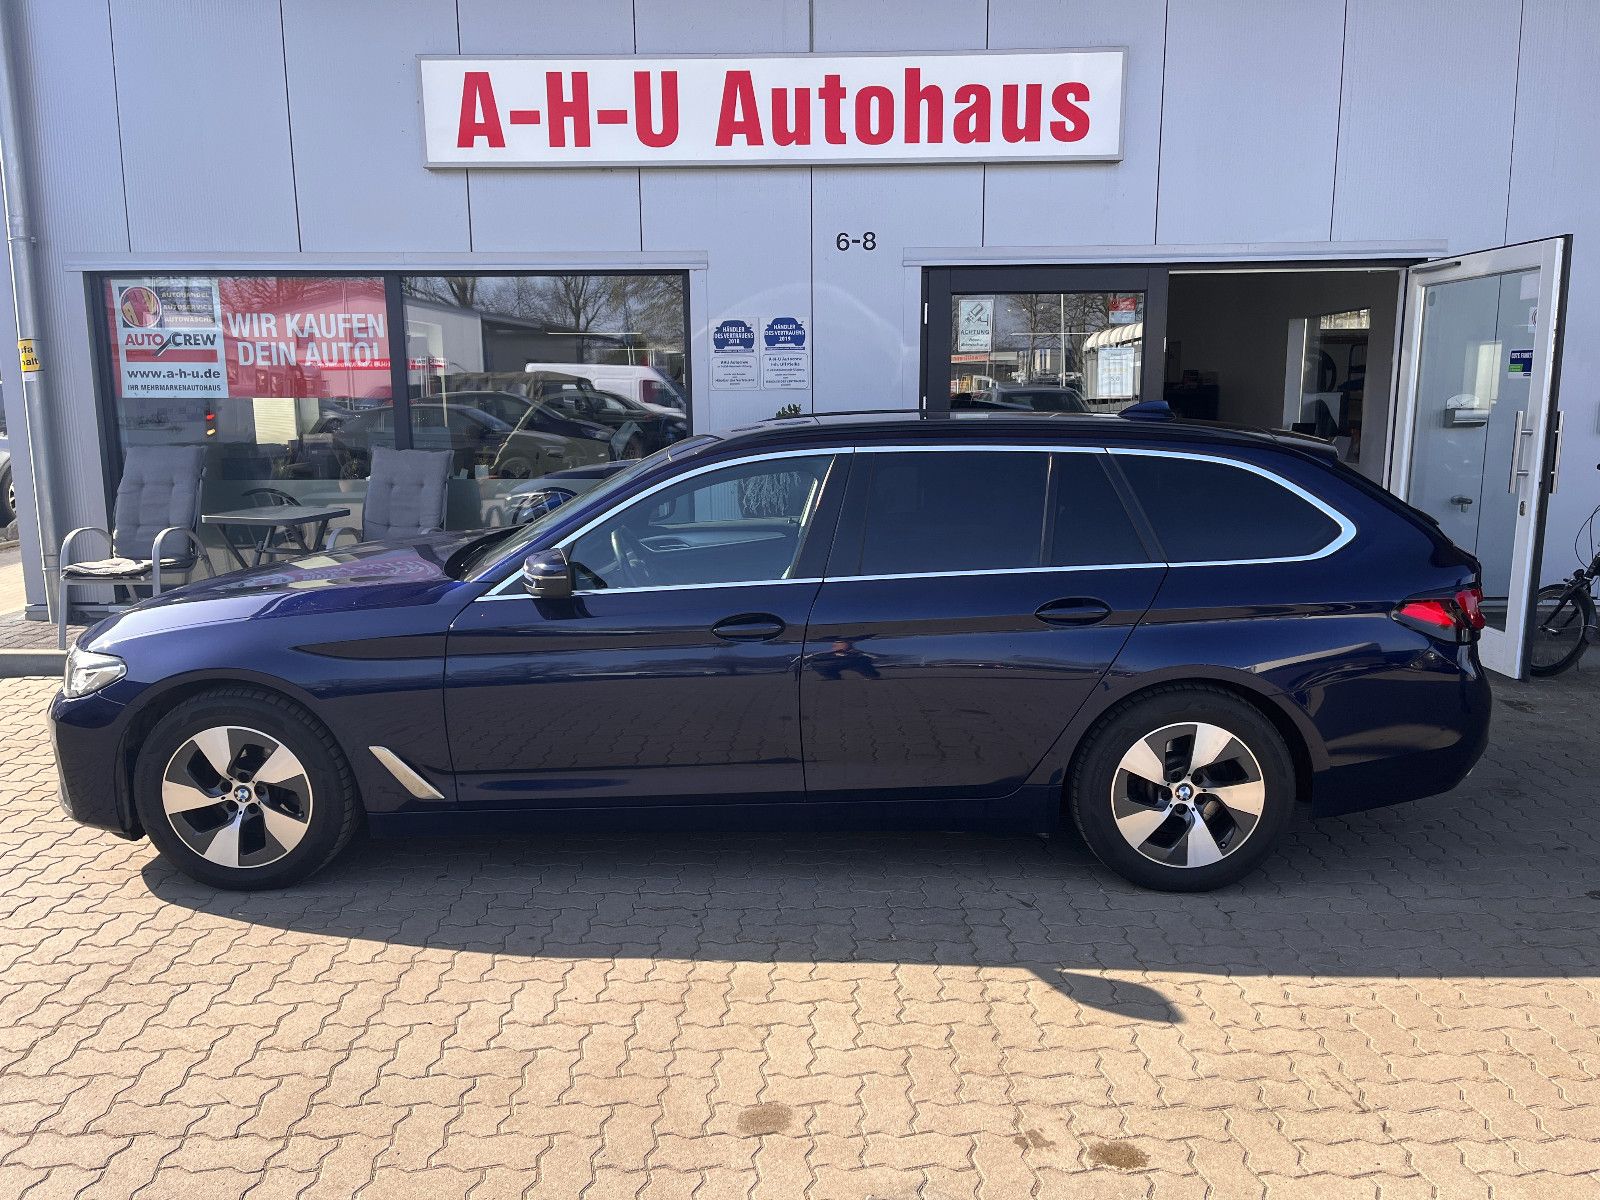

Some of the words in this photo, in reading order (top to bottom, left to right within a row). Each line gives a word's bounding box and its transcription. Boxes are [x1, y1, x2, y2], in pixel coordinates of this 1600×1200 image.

[457, 71, 679, 148] A-H-U
[715, 67, 1091, 146] Autohaus
[836, 231, 877, 251] 6-8
[227, 313, 277, 338] WIR
[285, 313, 385, 339] KAUFEN
[125, 334, 164, 346] AUTO
[171, 333, 217, 346] CREW
[238, 341, 296, 366] DEIN
[305, 341, 379, 367] AUTO!
[127, 369, 221, 379] www.a-h-u.de
